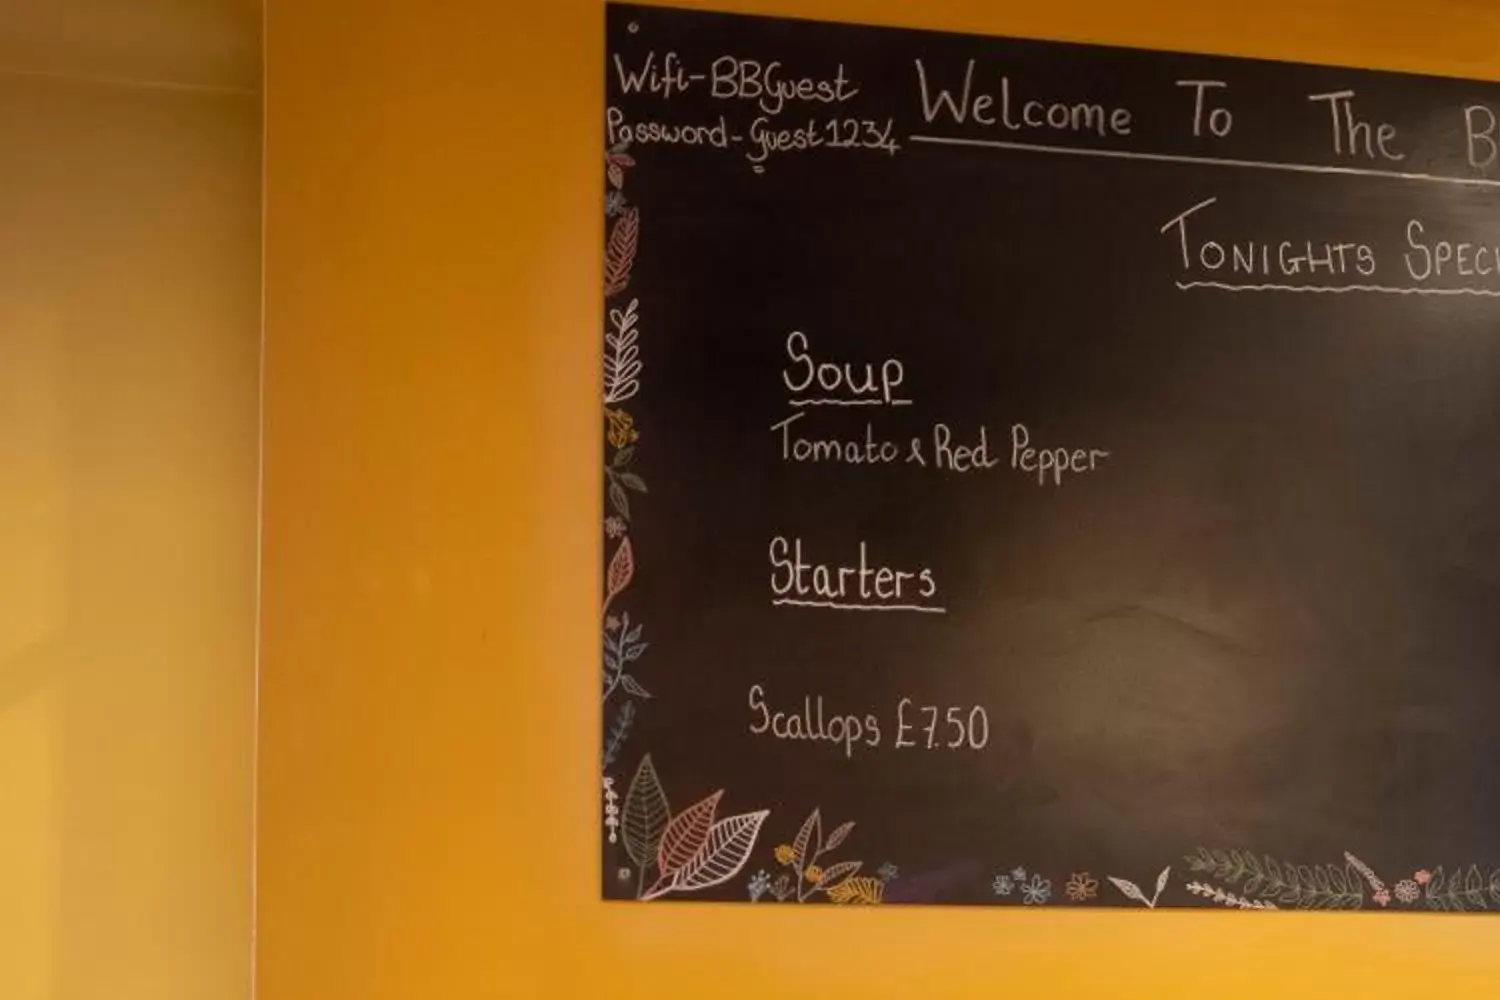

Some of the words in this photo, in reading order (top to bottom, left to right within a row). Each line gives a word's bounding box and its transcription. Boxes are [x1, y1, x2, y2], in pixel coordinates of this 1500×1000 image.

[915, 58, 1133, 135] Welcome
[1175, 79, 1233, 137] To
[1309, 90, 1405, 161] The
[783, 331, 904, 402] Soup
[770, 411, 898, 463] Tomato
[905, 437, 926, 466] &
[934, 423, 998, 472] Red
[1010, 423, 1109, 486] Pepper
[769, 535, 937, 600] Starters
[748, 684, 881, 758] Scallops
[895, 697, 990, 749] £7.50
